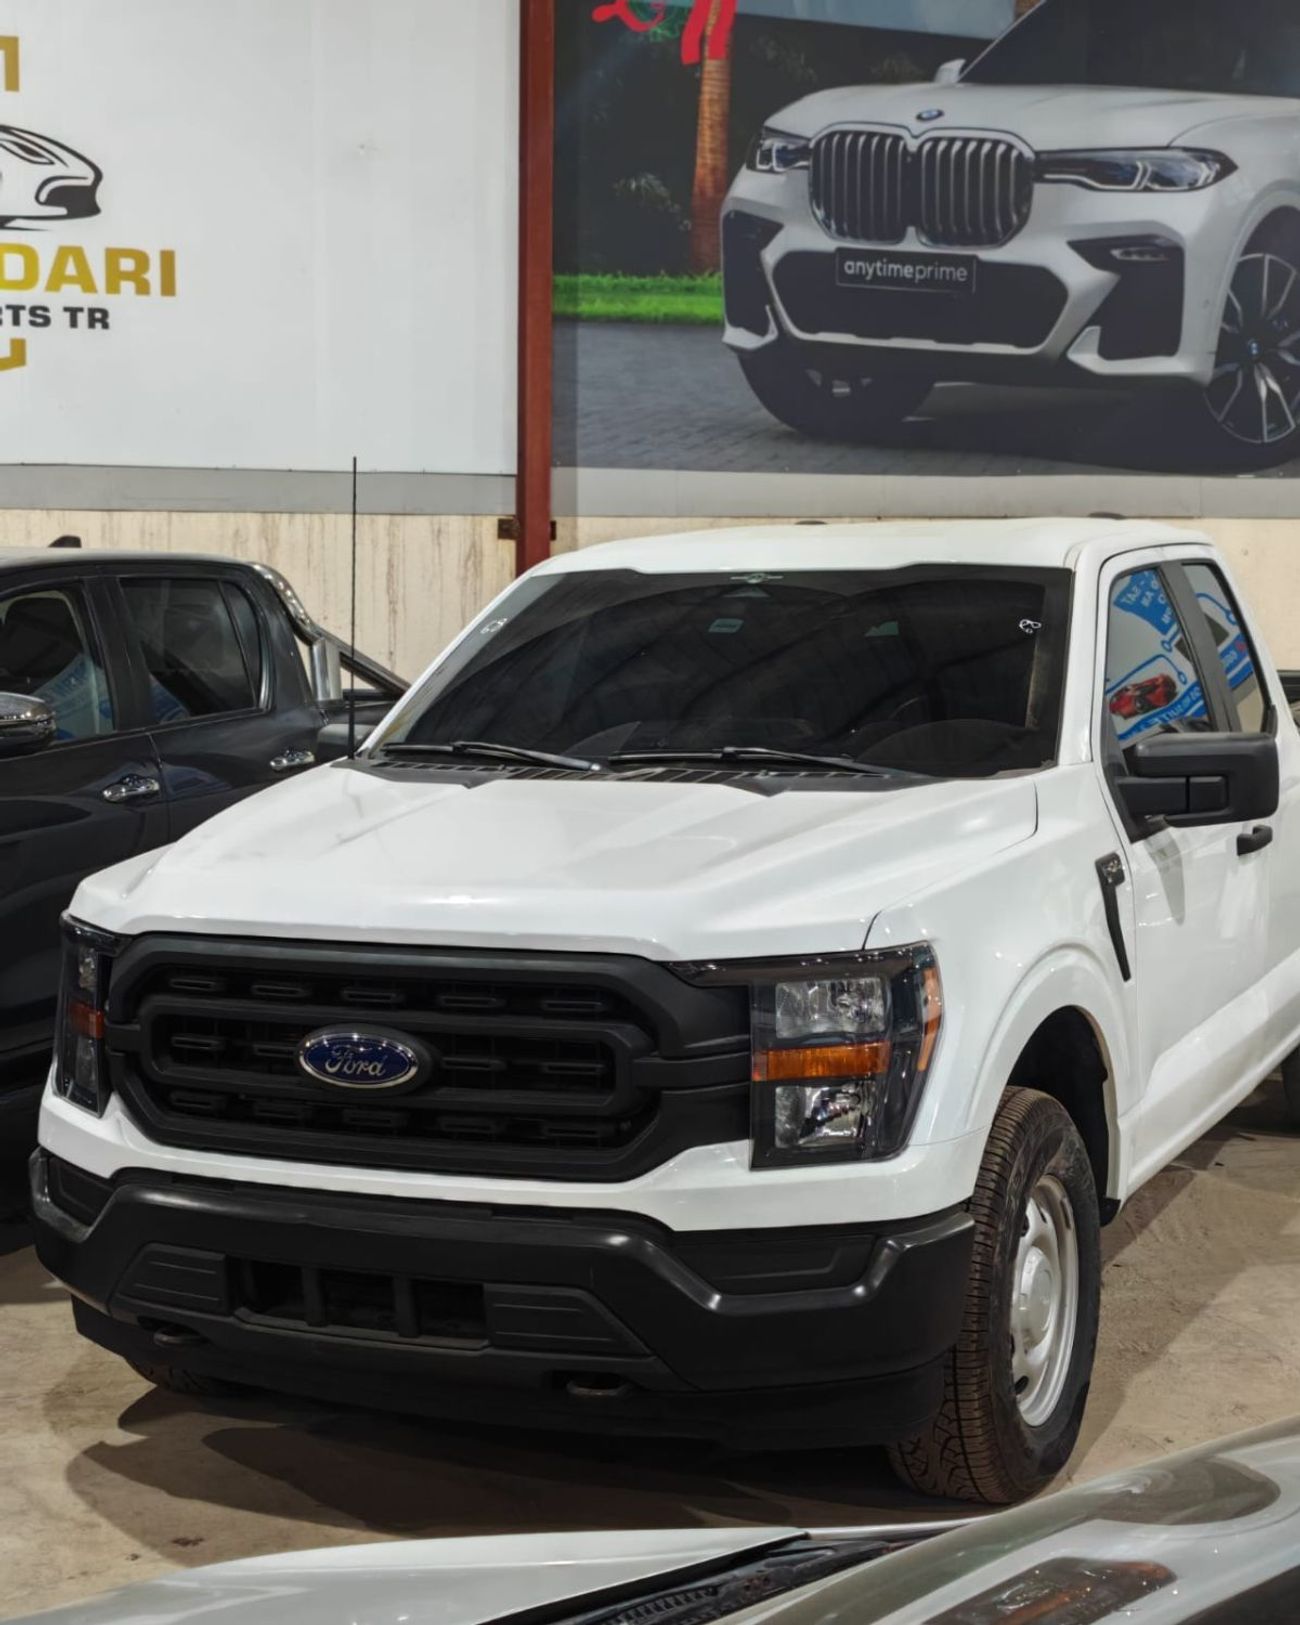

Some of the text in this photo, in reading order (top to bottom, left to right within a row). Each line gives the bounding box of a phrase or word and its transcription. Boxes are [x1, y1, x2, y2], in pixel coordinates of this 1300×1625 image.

[0, 304, 110, 330] TS TR
[325, 1044, 388, 1076] Ford
